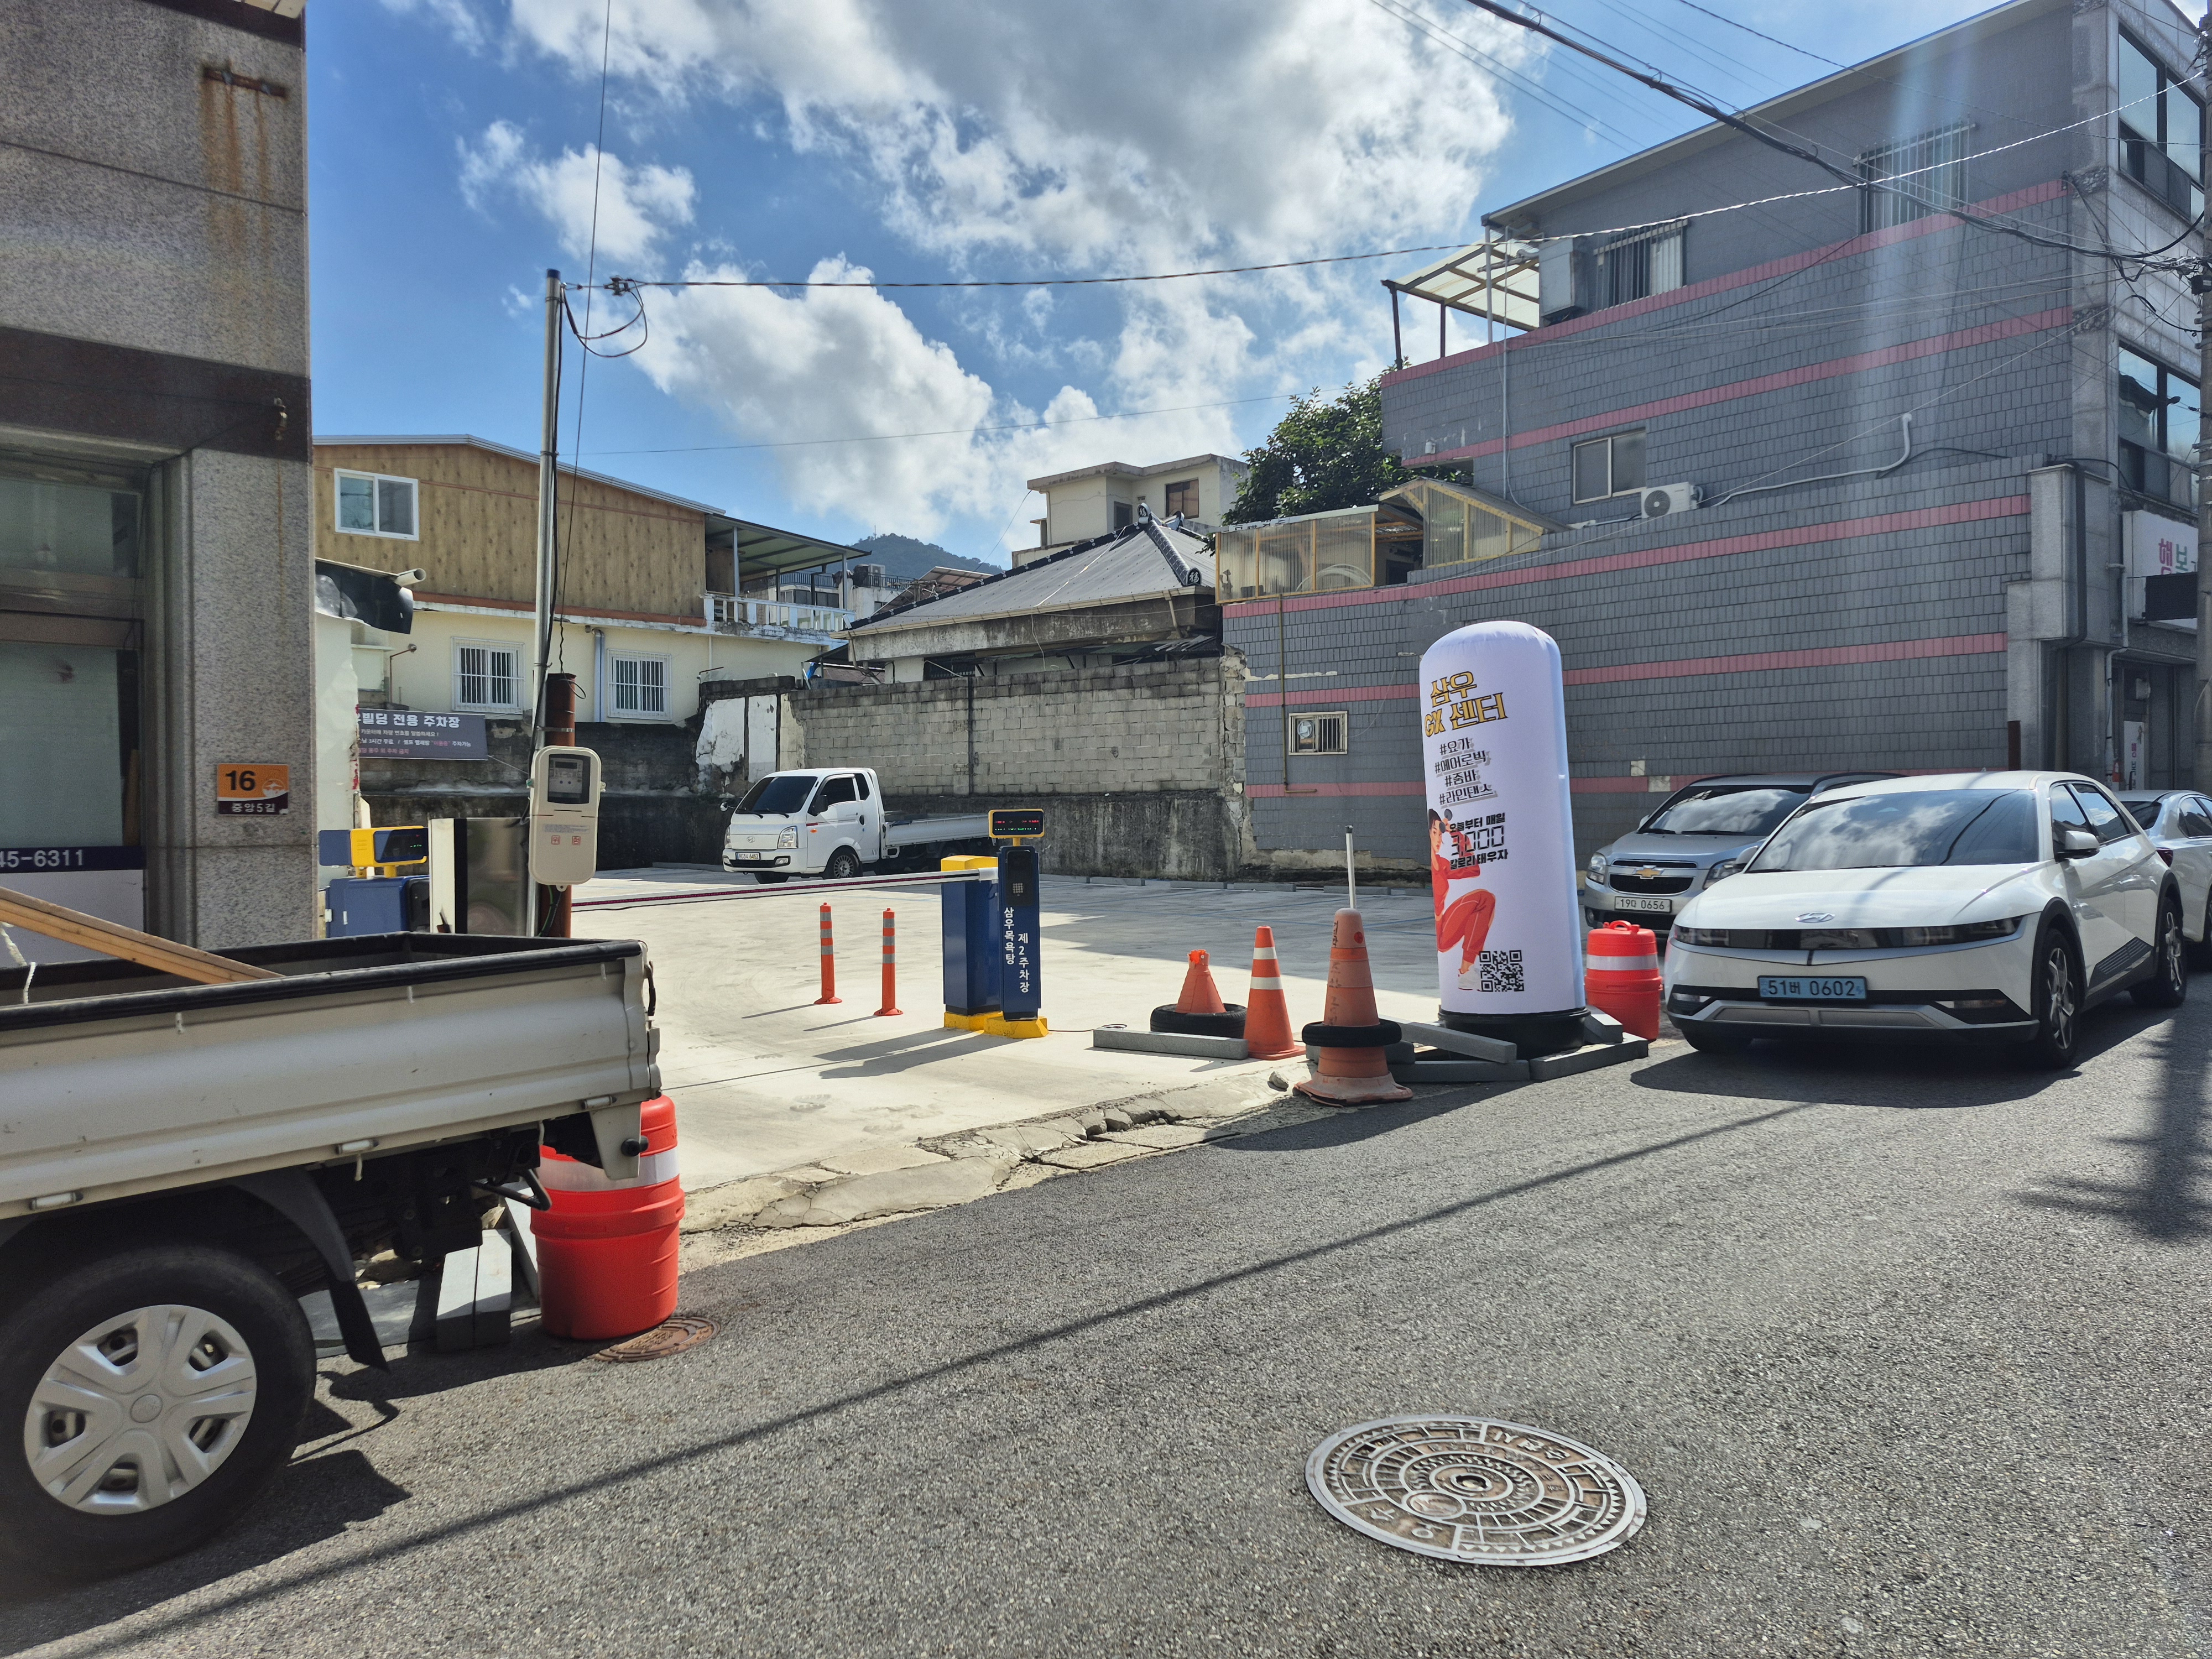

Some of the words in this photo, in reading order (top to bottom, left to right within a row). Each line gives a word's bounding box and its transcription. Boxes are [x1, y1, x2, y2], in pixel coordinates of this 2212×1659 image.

[1190, 571, 1199, 583] 福
[1431, 671, 1477, 707] 삼우
[393, 713, 419, 727] 전용
[424, 716, 460, 728] 주차장
[1425, 708, 1446, 737] GX
[1449, 692, 1508, 731] 센터
[1439, 737, 1472, 757] #요가
[1434, 750, 1487, 774] #에어로빅
[225, 770, 255, 791] 16
[1444, 769, 1478, 787] #줌바
[1439, 784, 1493, 806] #라인댄스
[232, 803, 275, 813] 중앙5길
[1449, 816, 1483, 833] 오늘부터
[1485, 812, 1506, 826] 매일
[1450, 826, 1505, 856] 3,000
[1449, 855, 1477, 870] 칼로리
[1476, 848, 1509, 865] 태우자
[1641, 900, 1665, 910] 0656
[1004, 907, 1015, 965] 삼우목욕탕
[1018, 932, 1030, 993] 제2주차장
[1768, 980, 1801, 995] 51버
[1809, 980, 1855, 996] 0602
